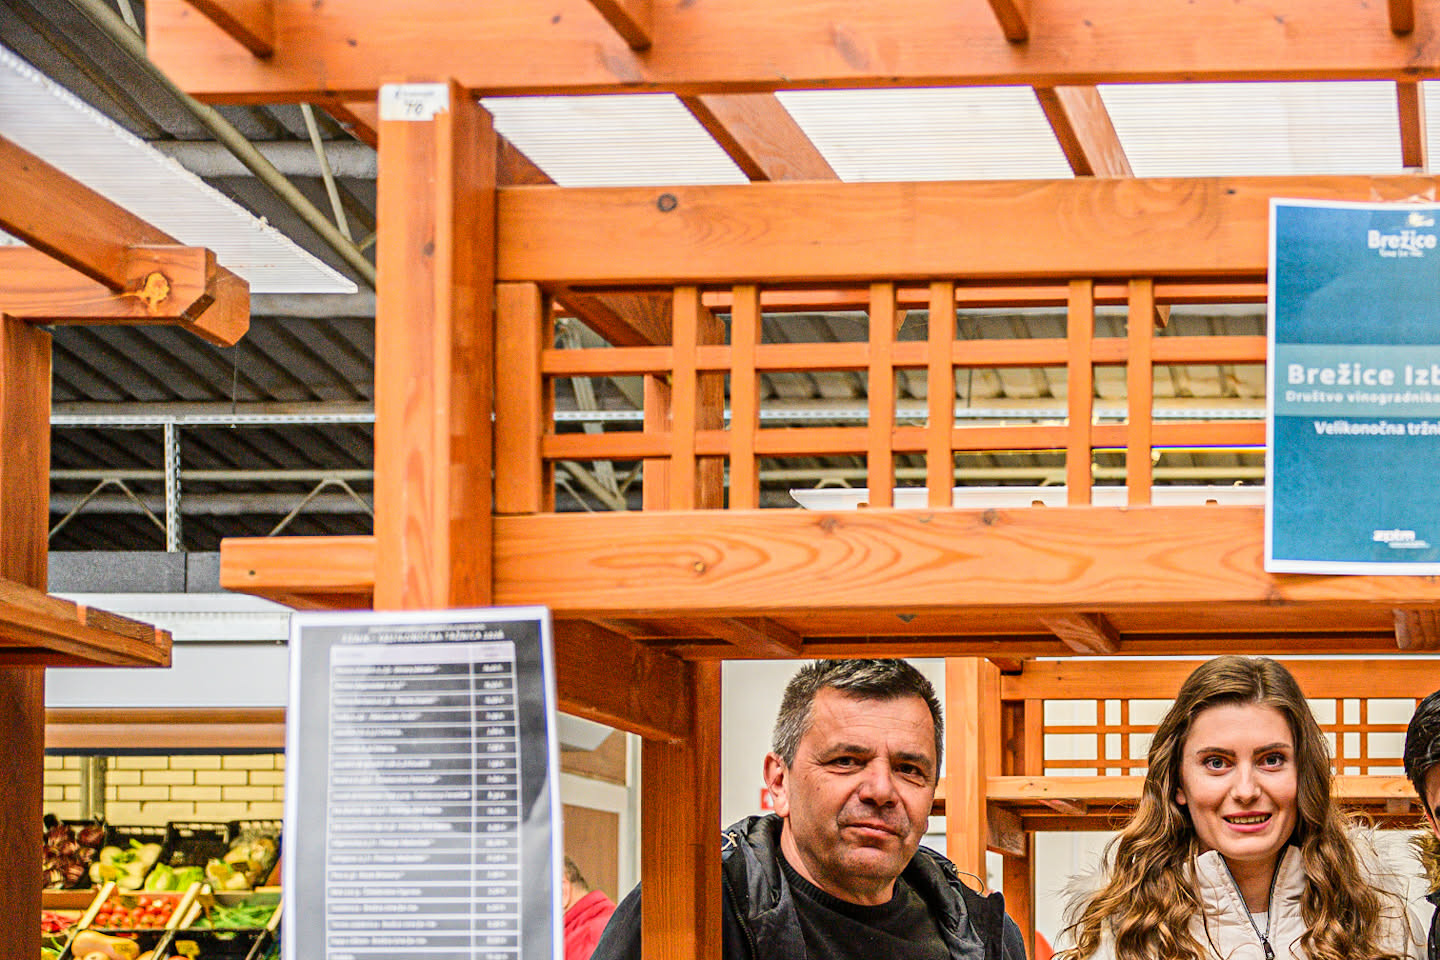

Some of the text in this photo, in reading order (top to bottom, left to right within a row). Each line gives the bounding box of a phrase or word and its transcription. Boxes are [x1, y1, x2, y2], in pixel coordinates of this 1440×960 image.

[1286, 362, 1396, 386] Brežice
[1285, 389, 1344, 404] Društvo
[1313, 420, 1406, 436] Velikonočna
